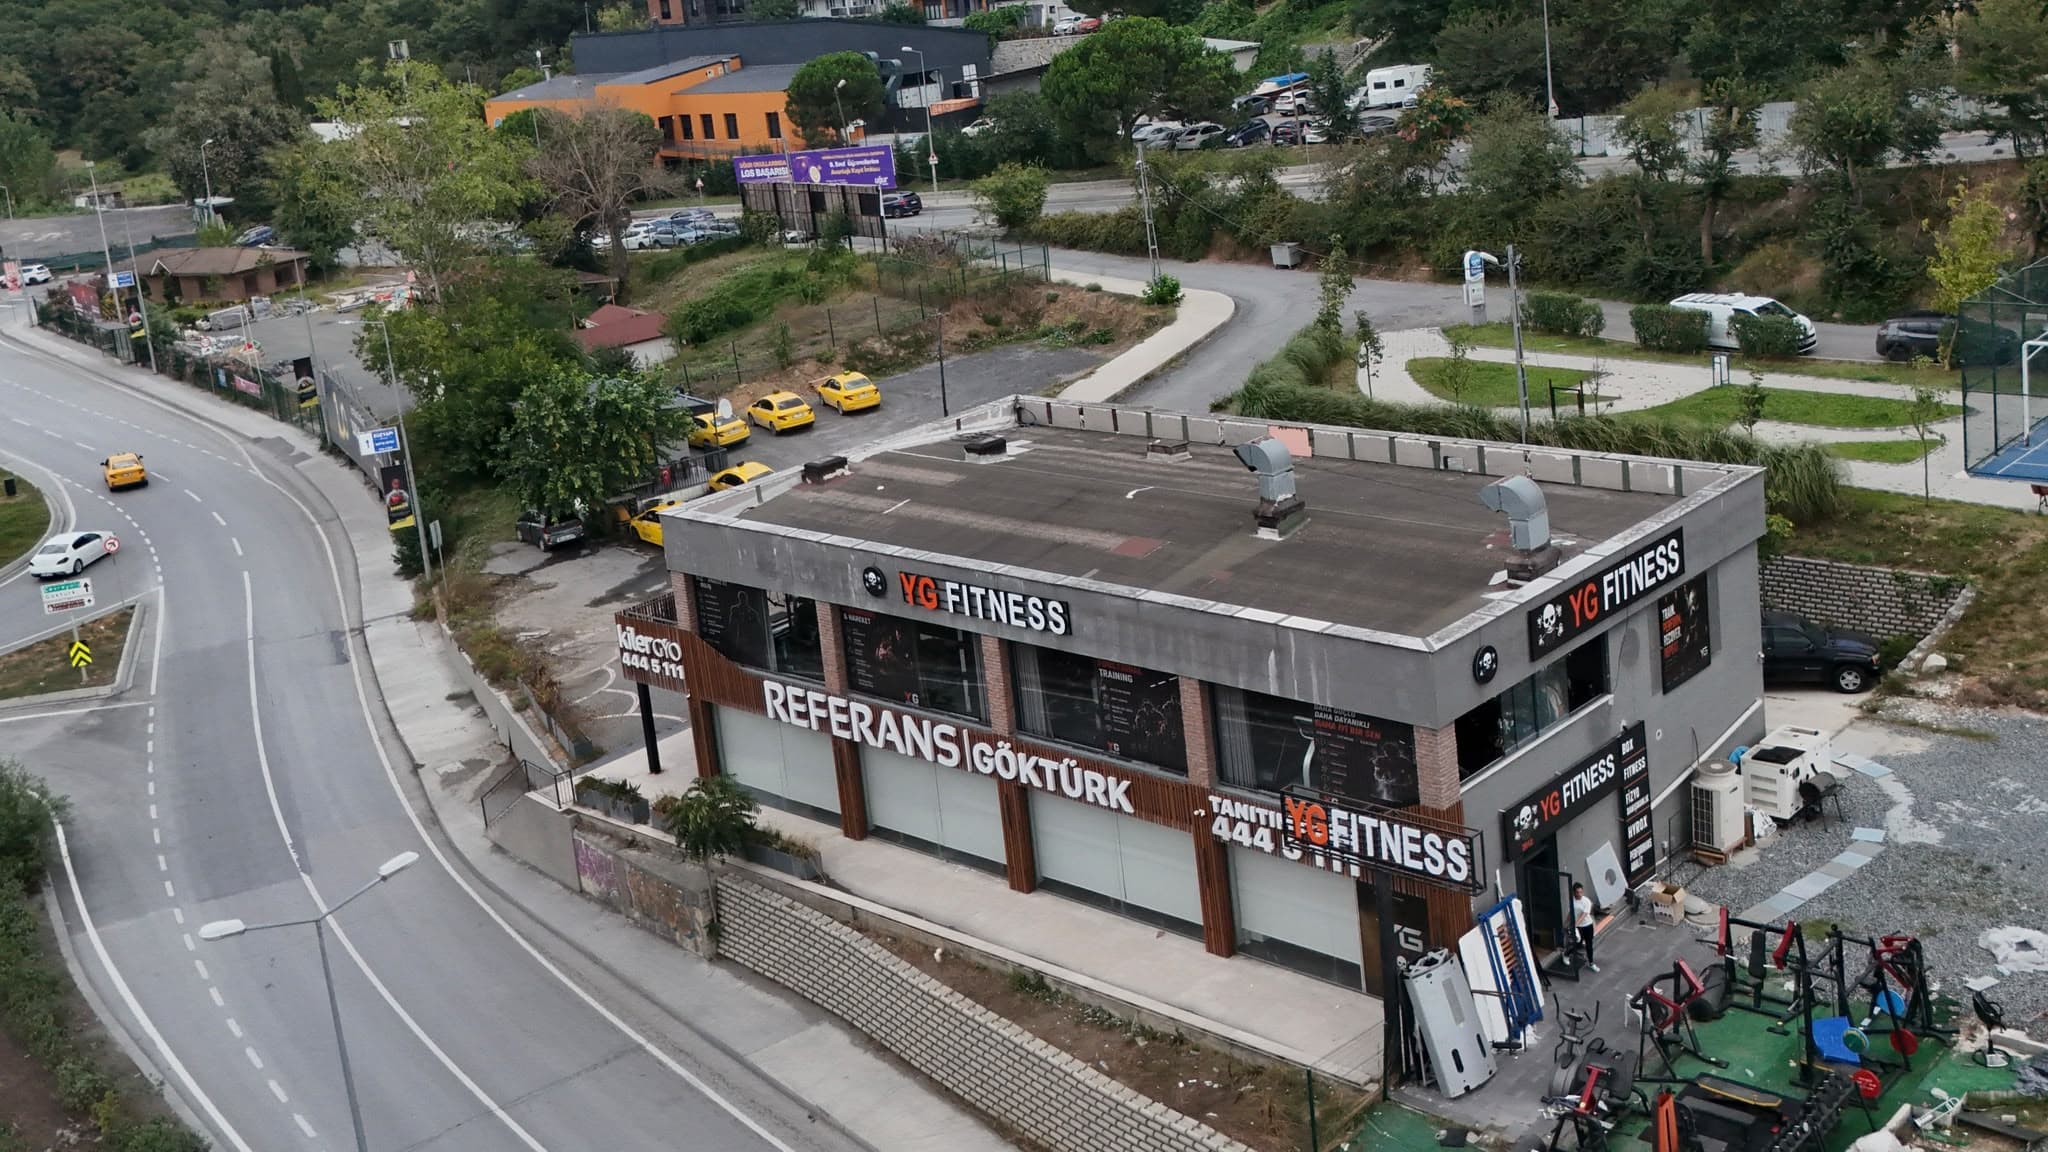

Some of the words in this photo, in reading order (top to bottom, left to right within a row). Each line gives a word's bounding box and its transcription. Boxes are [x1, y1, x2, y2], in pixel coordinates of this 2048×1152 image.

[1569, 582, 1599, 629] YG
[1603, 538, 1681, 611] FITNESS
[899, 571, 938, 610] YG
[945, 581, 1068, 636] FITNESS
[622, 652, 649, 671] 444
[650, 658, 661, 674] 5
[662, 661, 685, 680] 111
[1098, 668, 1133, 684] TRAINING
[1314, 711, 1333, 721] DAHA
[763, 680, 961, 769] REFERANS
[972, 740, 1134, 814] GÖKTÜRK
[1621, 737, 1634, 755] BOX
[1623, 756, 1646, 781] FITNESS
[1540, 791, 1561, 823] YG
[1562, 752, 1616, 810] FITNESS
[1212, 815, 1275, 853] 444
[1285, 796, 1329, 846] YG
[1330, 807, 1469, 882] FITNESS
[1628, 815, 1648, 840] HYROX
